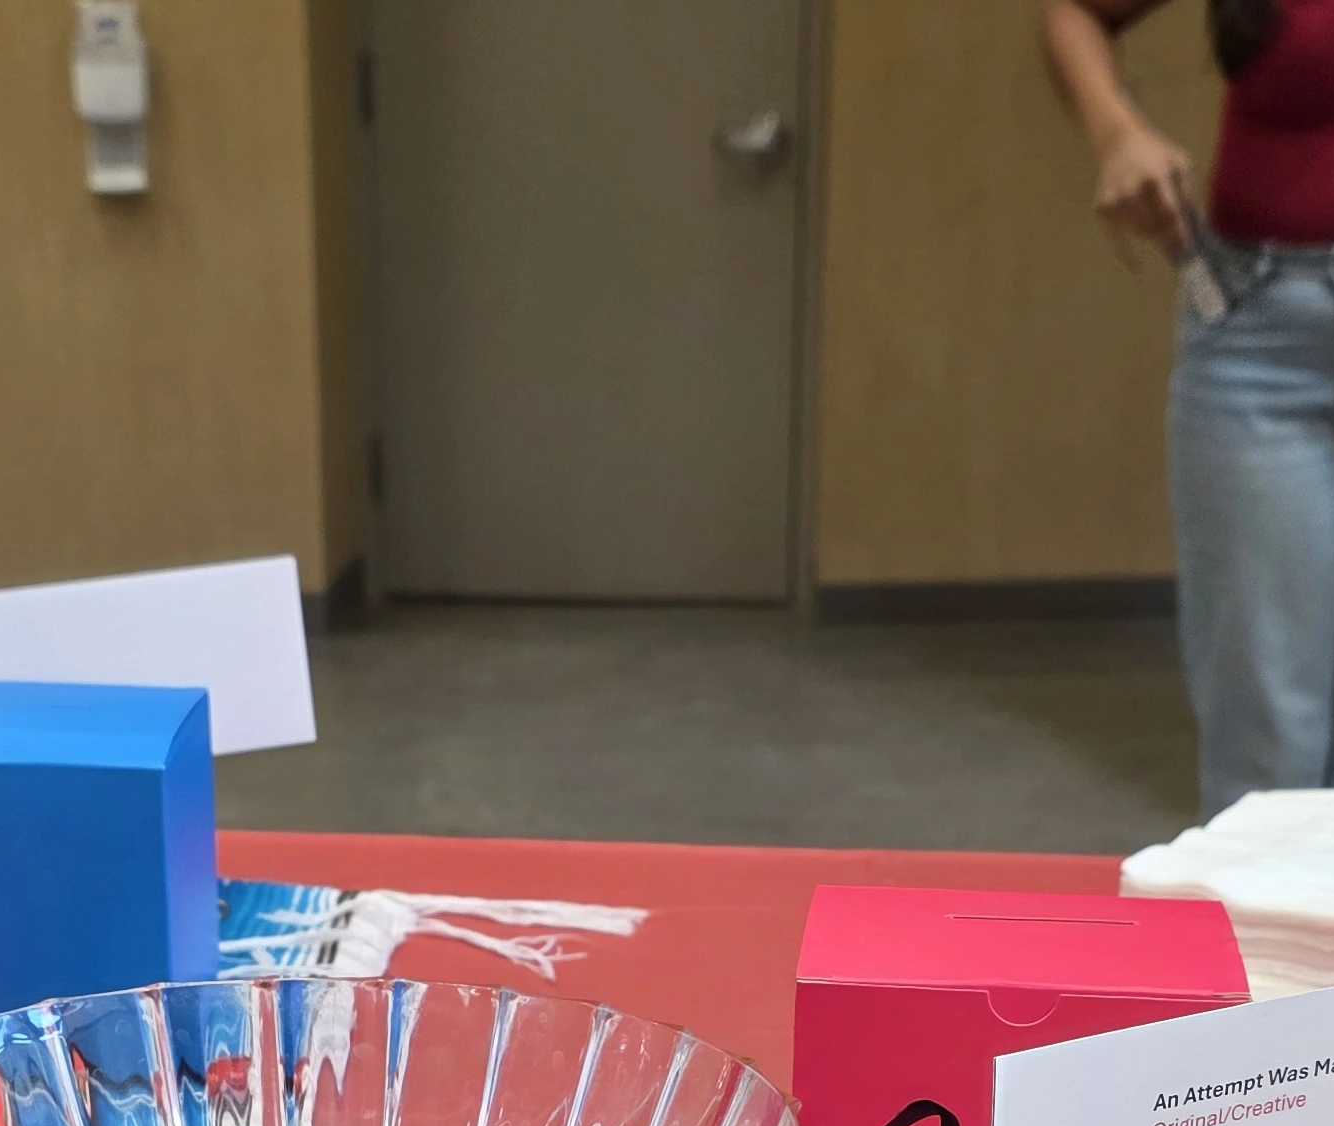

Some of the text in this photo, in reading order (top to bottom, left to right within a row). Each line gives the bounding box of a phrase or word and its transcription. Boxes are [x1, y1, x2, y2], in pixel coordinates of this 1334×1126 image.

[1153, 1092, 1180, 1112] An
[1183, 1073, 1264, 1106] Attempt
[1268, 1064, 1309, 1086] Was
